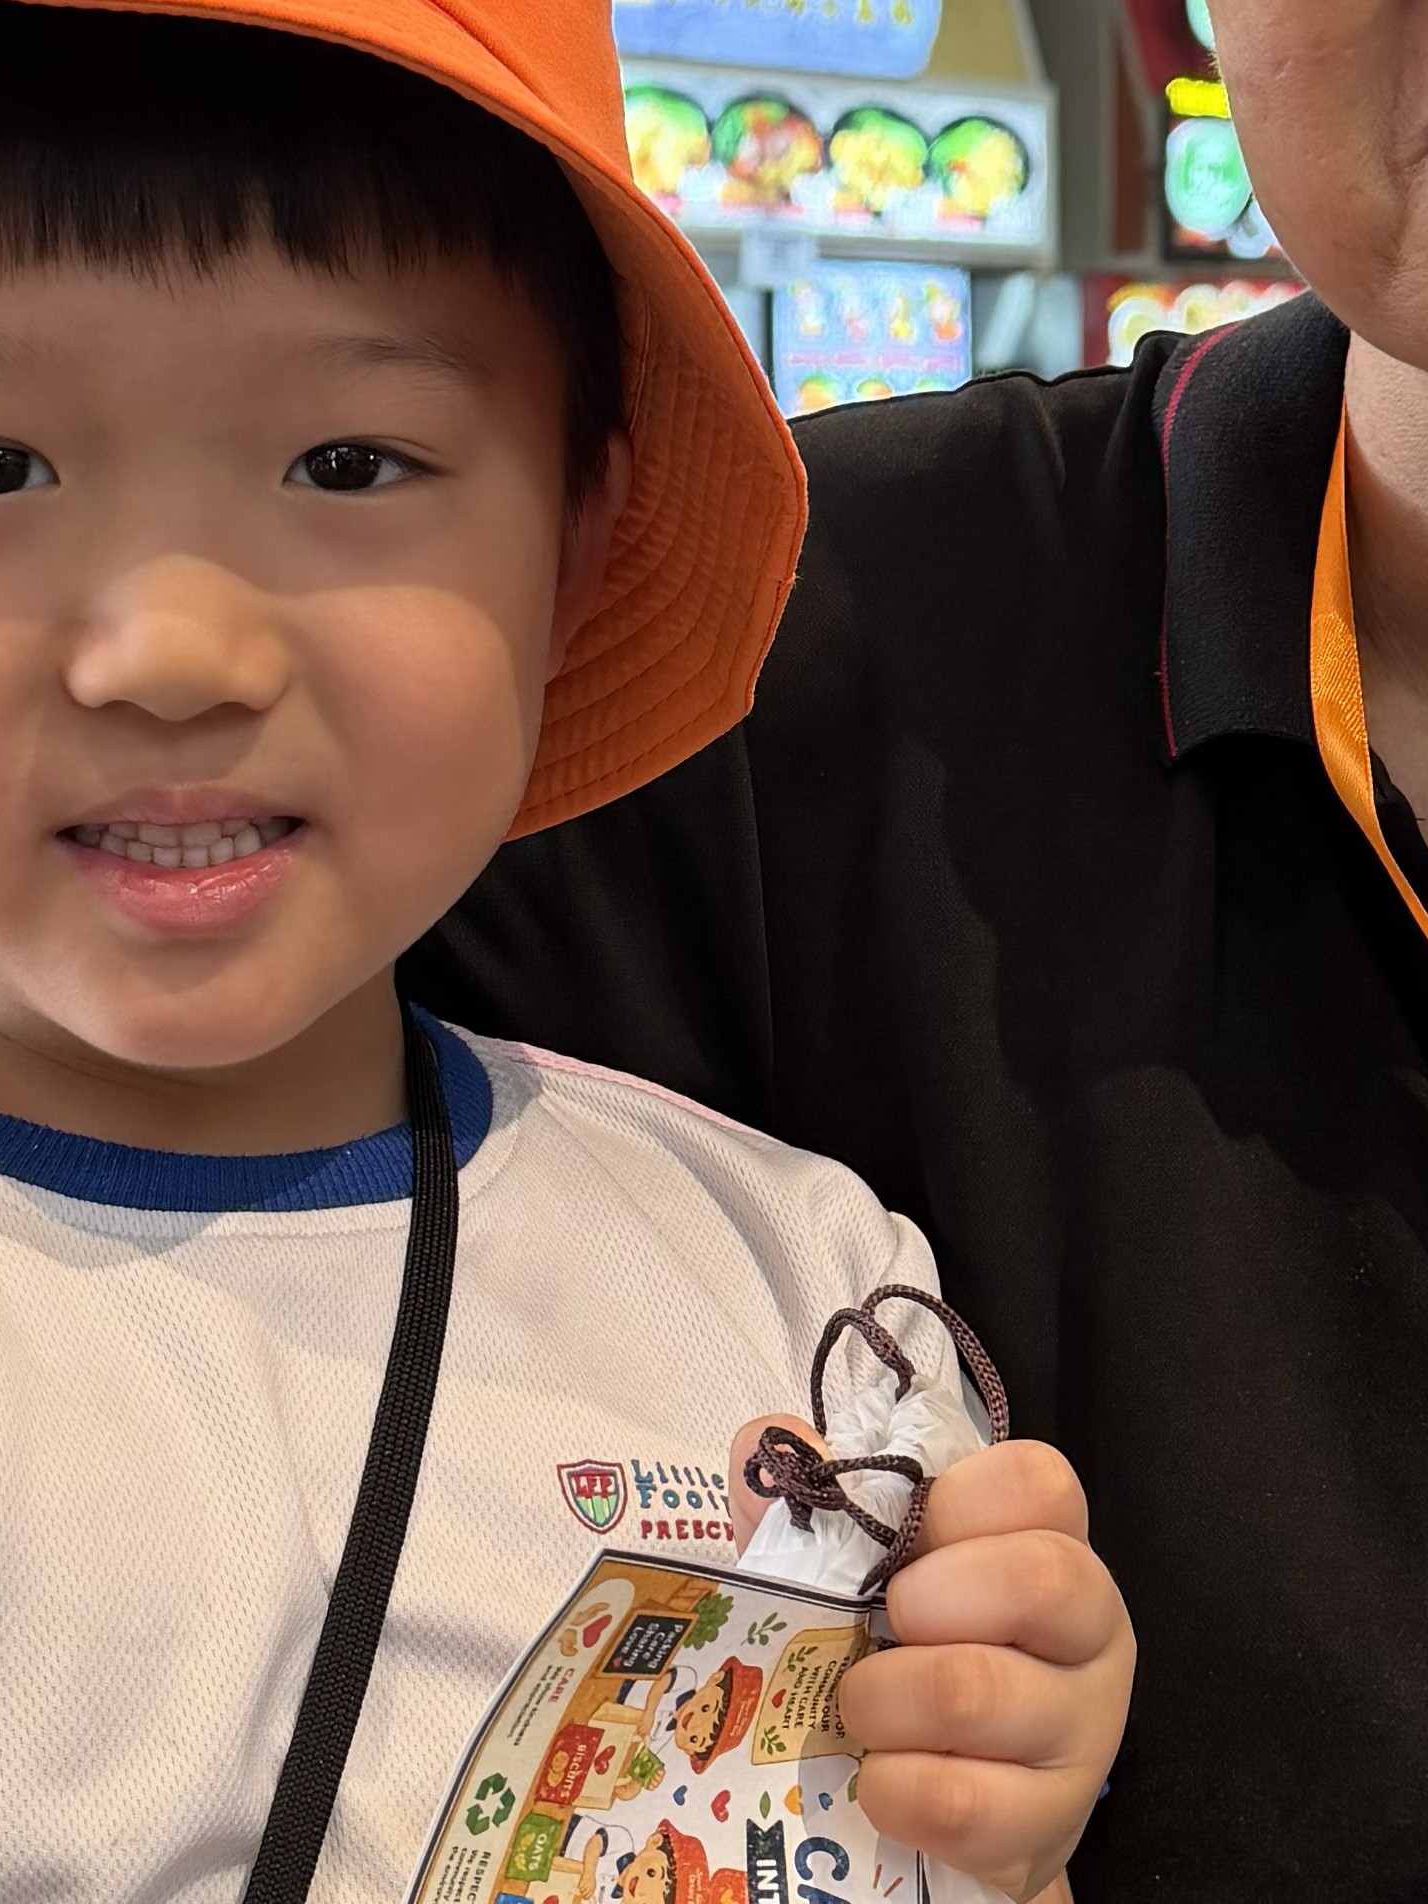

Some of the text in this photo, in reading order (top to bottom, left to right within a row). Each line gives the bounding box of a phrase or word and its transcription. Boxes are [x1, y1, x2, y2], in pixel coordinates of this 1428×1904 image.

[642, 1630, 666, 1661] Care
[647, 1622, 685, 1671] Packing
[782, 1692, 798, 1730] HEART
[794, 1696, 807, 1730] CARE
[808, 1660, 837, 1729] COMMUNITY
[820, 1705, 831, 1733] OUR
[559, 1743, 586, 1799] BISCUITS
[527, 1832, 549, 1872] OATS
